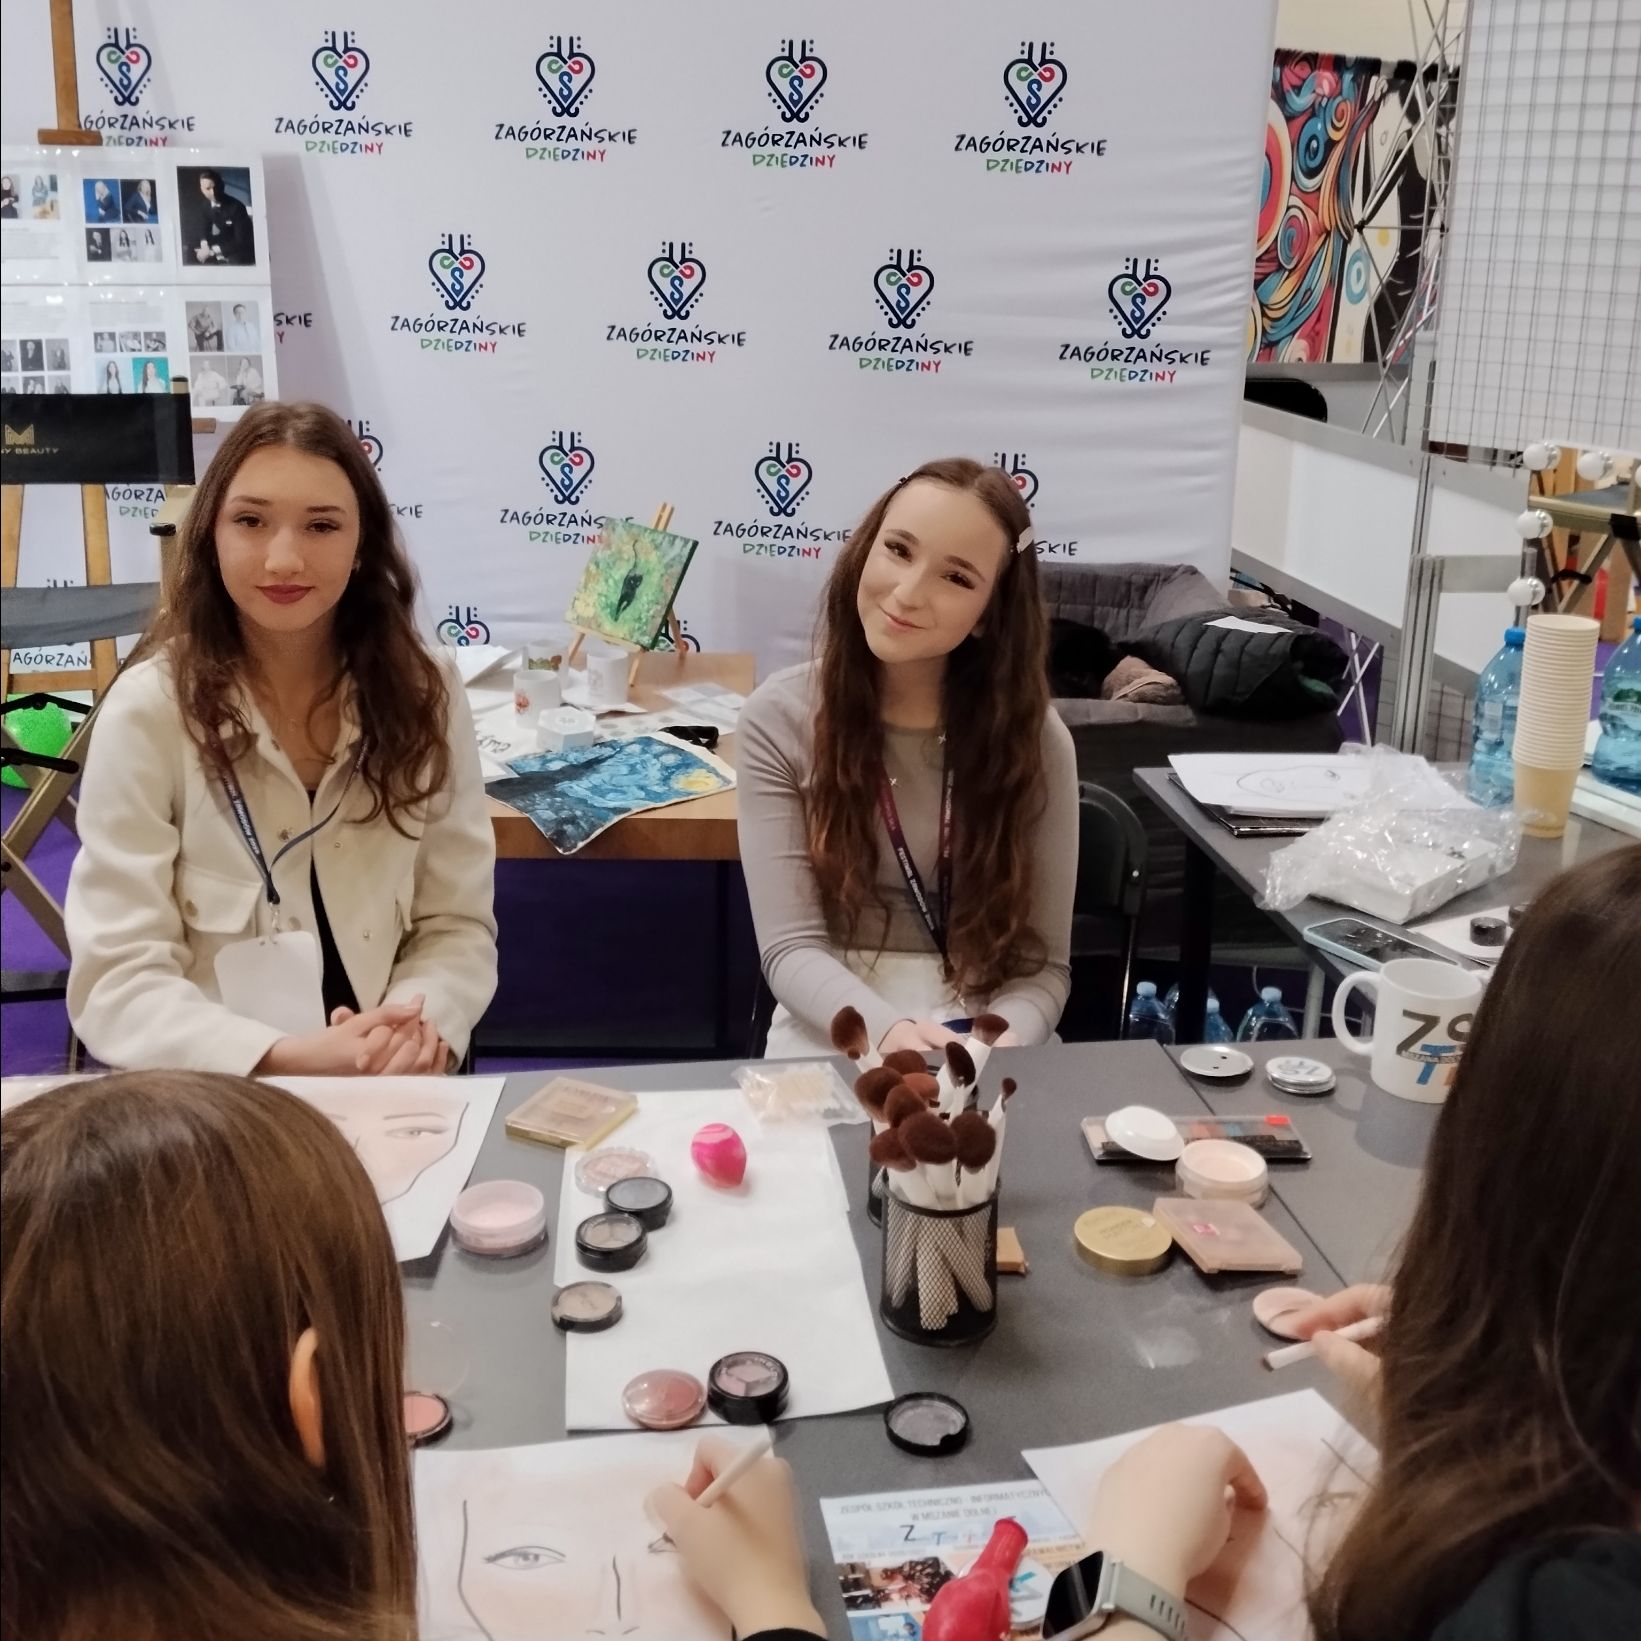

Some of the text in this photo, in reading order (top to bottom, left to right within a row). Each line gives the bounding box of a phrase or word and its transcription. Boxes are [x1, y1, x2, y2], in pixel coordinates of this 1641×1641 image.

[82, 110, 194, 134] GÓRZAŃSKIE
[275, 110, 412, 137] ZAGÓRZAŃSKIE
[495, 120, 637, 144] ZAGÓRZAŃSKIE
[722, 126, 868, 149] ZAGÓRZAŃSKIE
[107, 136, 167, 147] ZIEDZINY
[305, 140, 383, 154] DZIEDZINY
[955, 131, 1107, 156] ZAGÓRZAŃSKIE
[526, 147, 606, 162] DZIEDZINY
[753, 153, 835, 168] DZIEDZINY
[987, 159, 1072, 174] DZIEDZINY
[391, 313, 526, 337] ZAGÓRZAŃSKIE
[607, 323, 745, 346] ZAGÓRZAŃSKIE
[421, 339, 497, 353] DZIEDZINY
[829, 332, 973, 356] ZAGÓRZAŃSKIE
[637, 348, 715, 363] DZIEDZINY
[1059, 341, 1210, 366] ZAGÓRZAŃSKIE
[859, 358, 941, 373] DZIEDZINY
[1091, 368, 1176, 383] DZIEDZINY
[15, 447, 60, 455] BEAUTY
[500, 507, 634, 529] ZAGÓRZAŃS
[713, 519, 851, 543] ZAGÓRZAŃSKIE
[743, 544, 821, 559] DZIEDZINY
[12, 647, 89, 668] AGÓRZAŃ
[970, 1488, 1051, 1504] INFORMATYCZNYC
